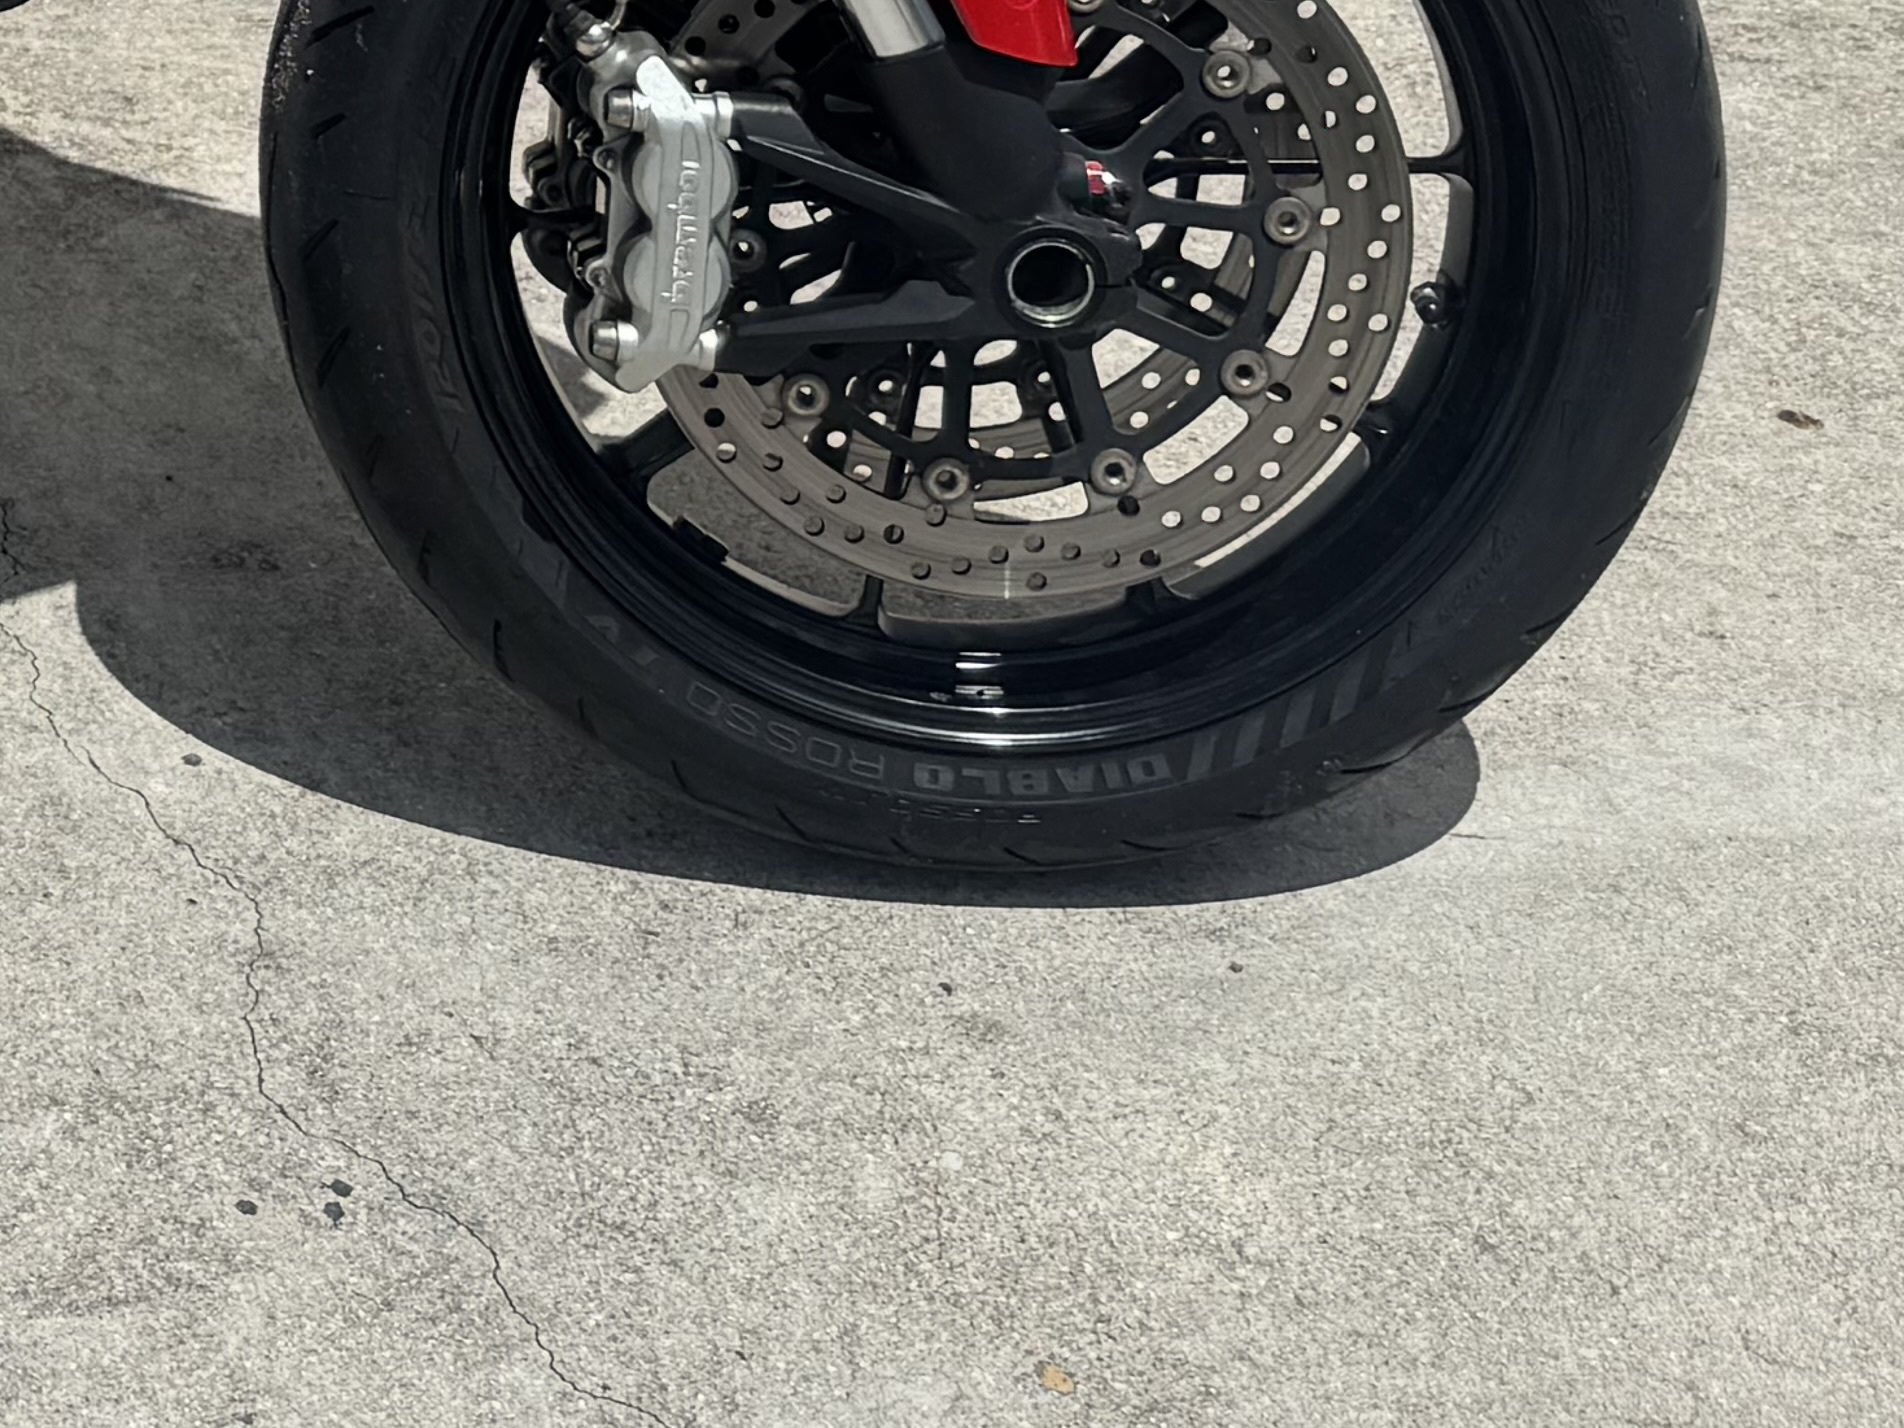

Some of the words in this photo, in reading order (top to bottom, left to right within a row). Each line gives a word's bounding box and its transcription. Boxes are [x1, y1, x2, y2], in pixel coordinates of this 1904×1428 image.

[660, 167, 701, 304] brembo
[681, 677, 887, 780] ROSSO
[912, 752, 1174, 797] DIABLO
